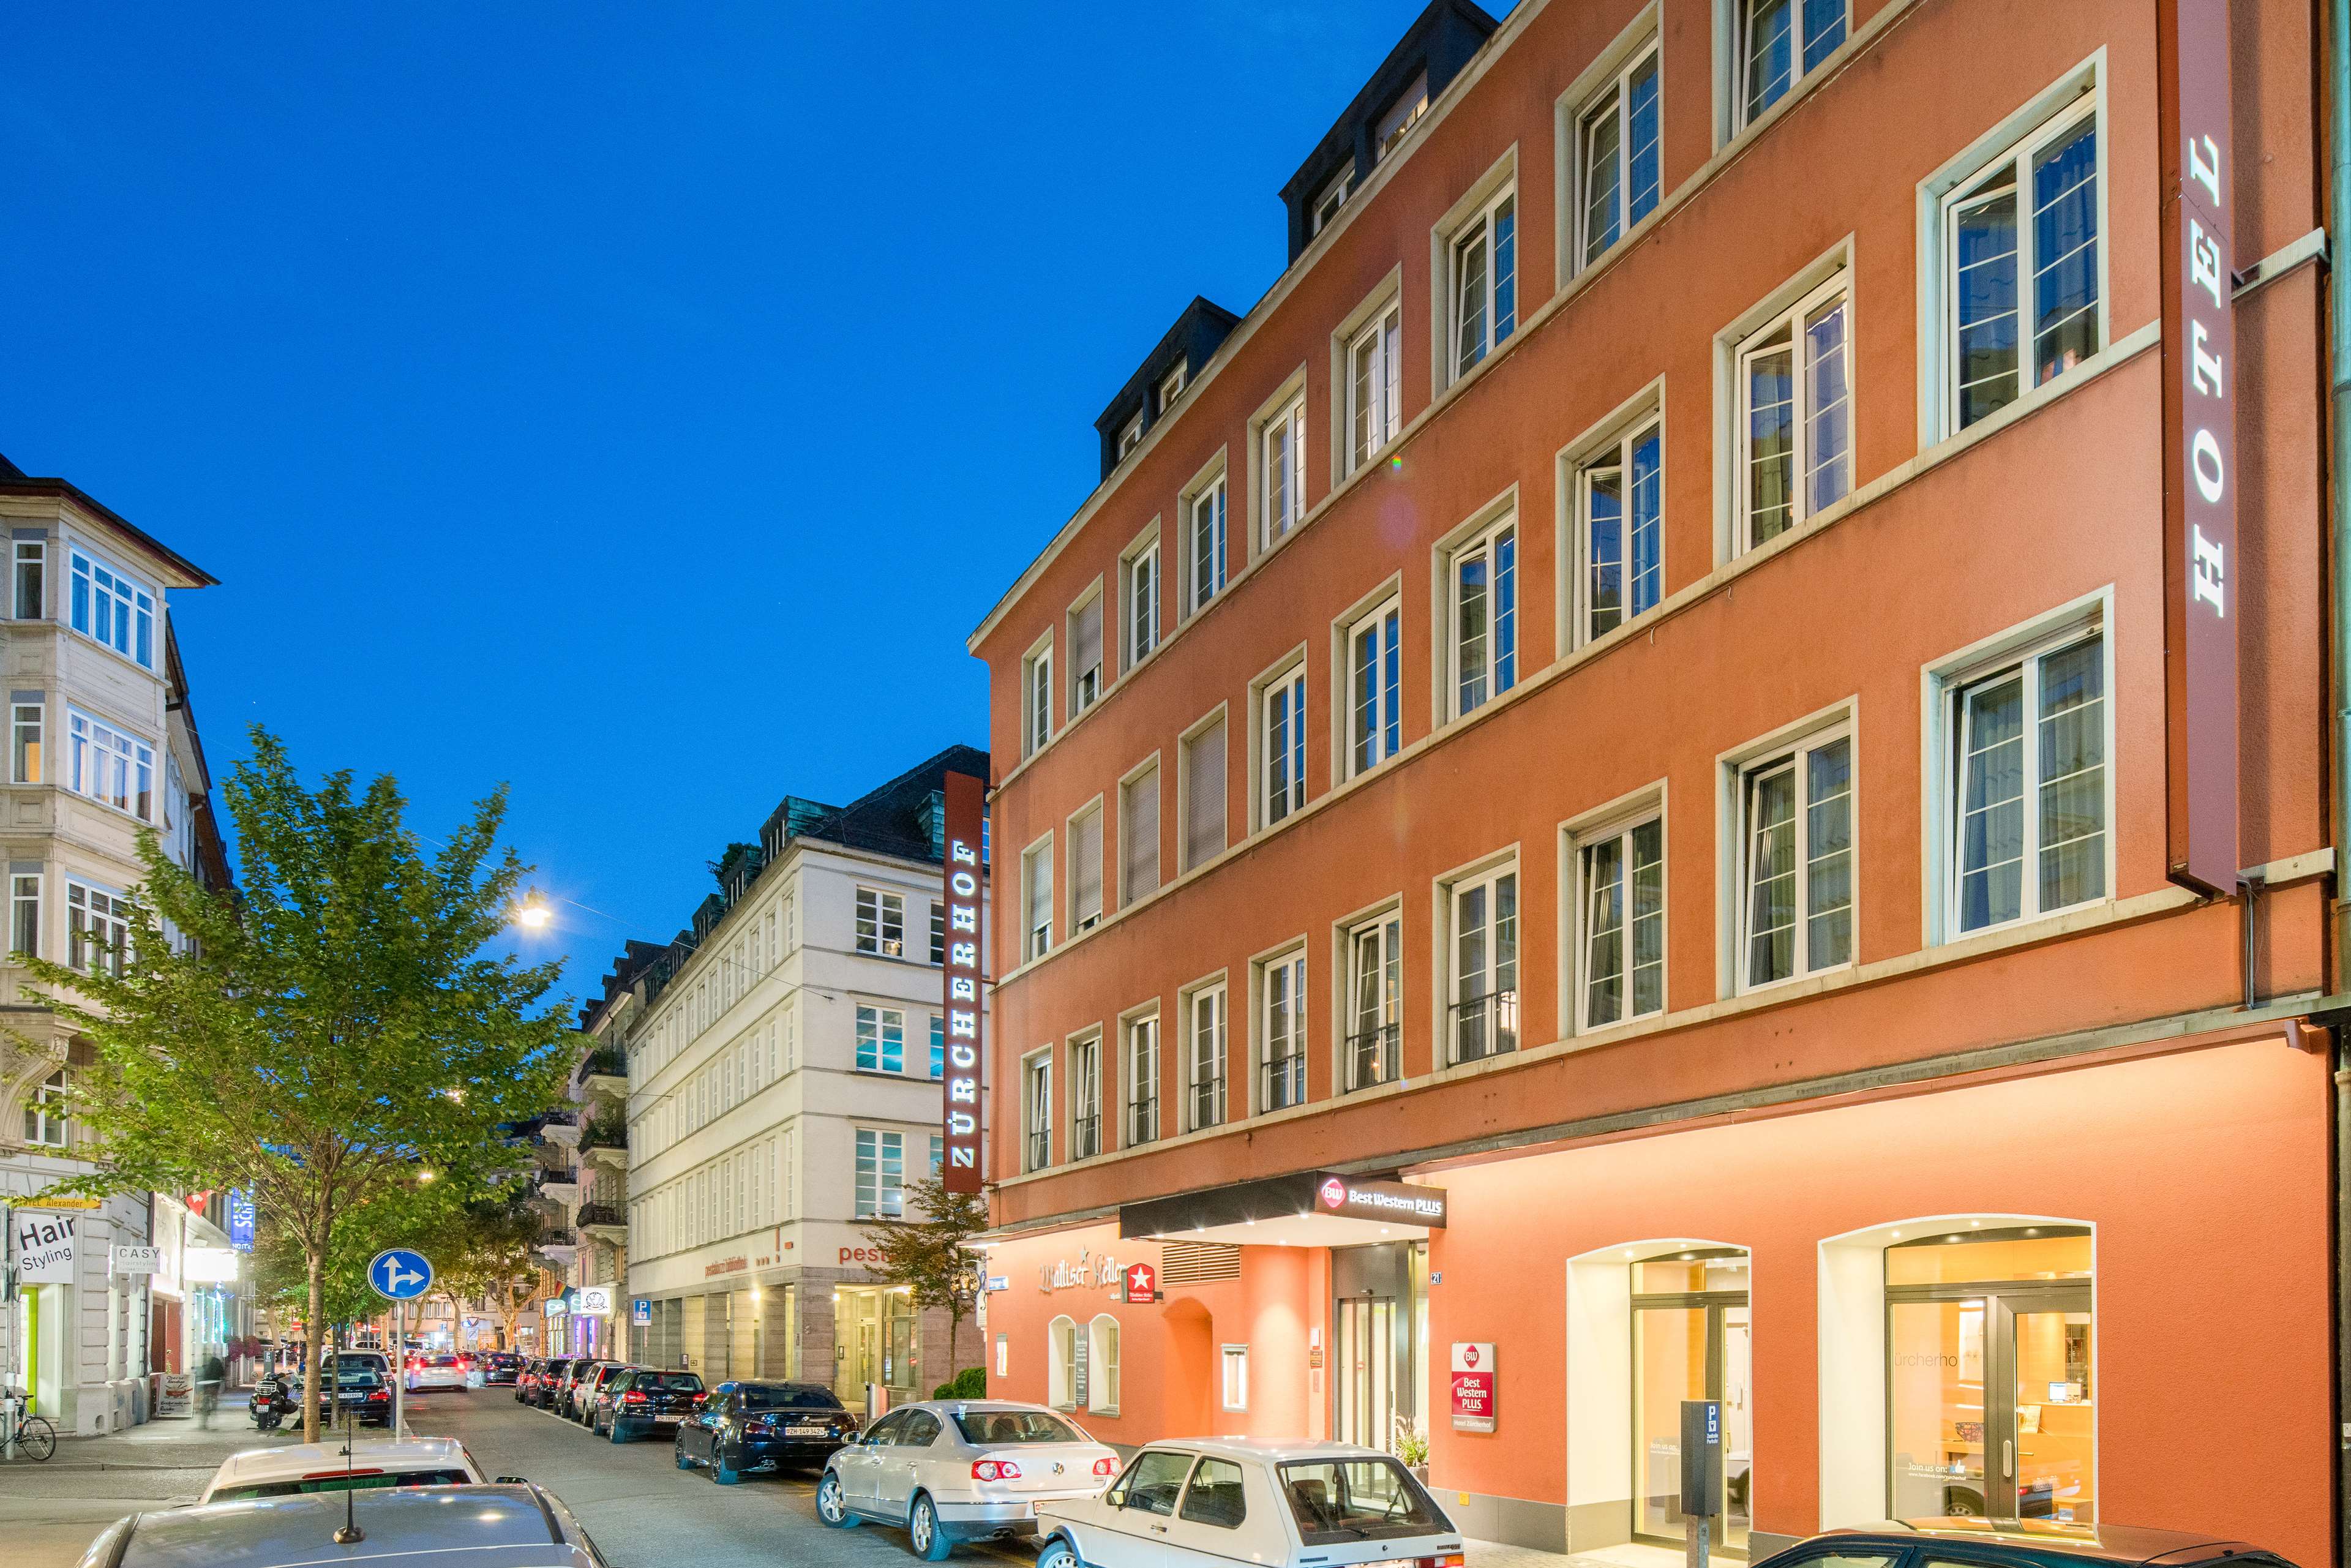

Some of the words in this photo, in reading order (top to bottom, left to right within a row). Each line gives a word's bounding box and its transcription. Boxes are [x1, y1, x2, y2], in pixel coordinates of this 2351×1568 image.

[2190, 135, 2223, 617] HOTEL
[948, 841, 975, 1168] ZÜRCHERHOF
[1325, 1187, 1343, 1200] BW
[47, 1198, 83, 1207] Alexander
[1349, 1190, 1373, 1204] Best
[1373, 1194, 1414, 1210] Western
[1415, 1199, 1441, 1213] PLUS
[20, 1215, 74, 1251] Hair
[23, 1248, 72, 1271] Styling
[119, 1248, 159, 1259] CASY
[1432, 1274, 1440, 1283] 21
[640, 1302, 647, 1311] P
[1466, 1351, 1477, 1361] BW
[1895, 1352, 1959, 1367] ürcherho
[1464, 1378, 1480, 1388] Best
[1457, 1387, 1487, 1398] Western
[1709, 1405, 1715, 1420] P
[1908, 1463, 1923, 1472] Join
